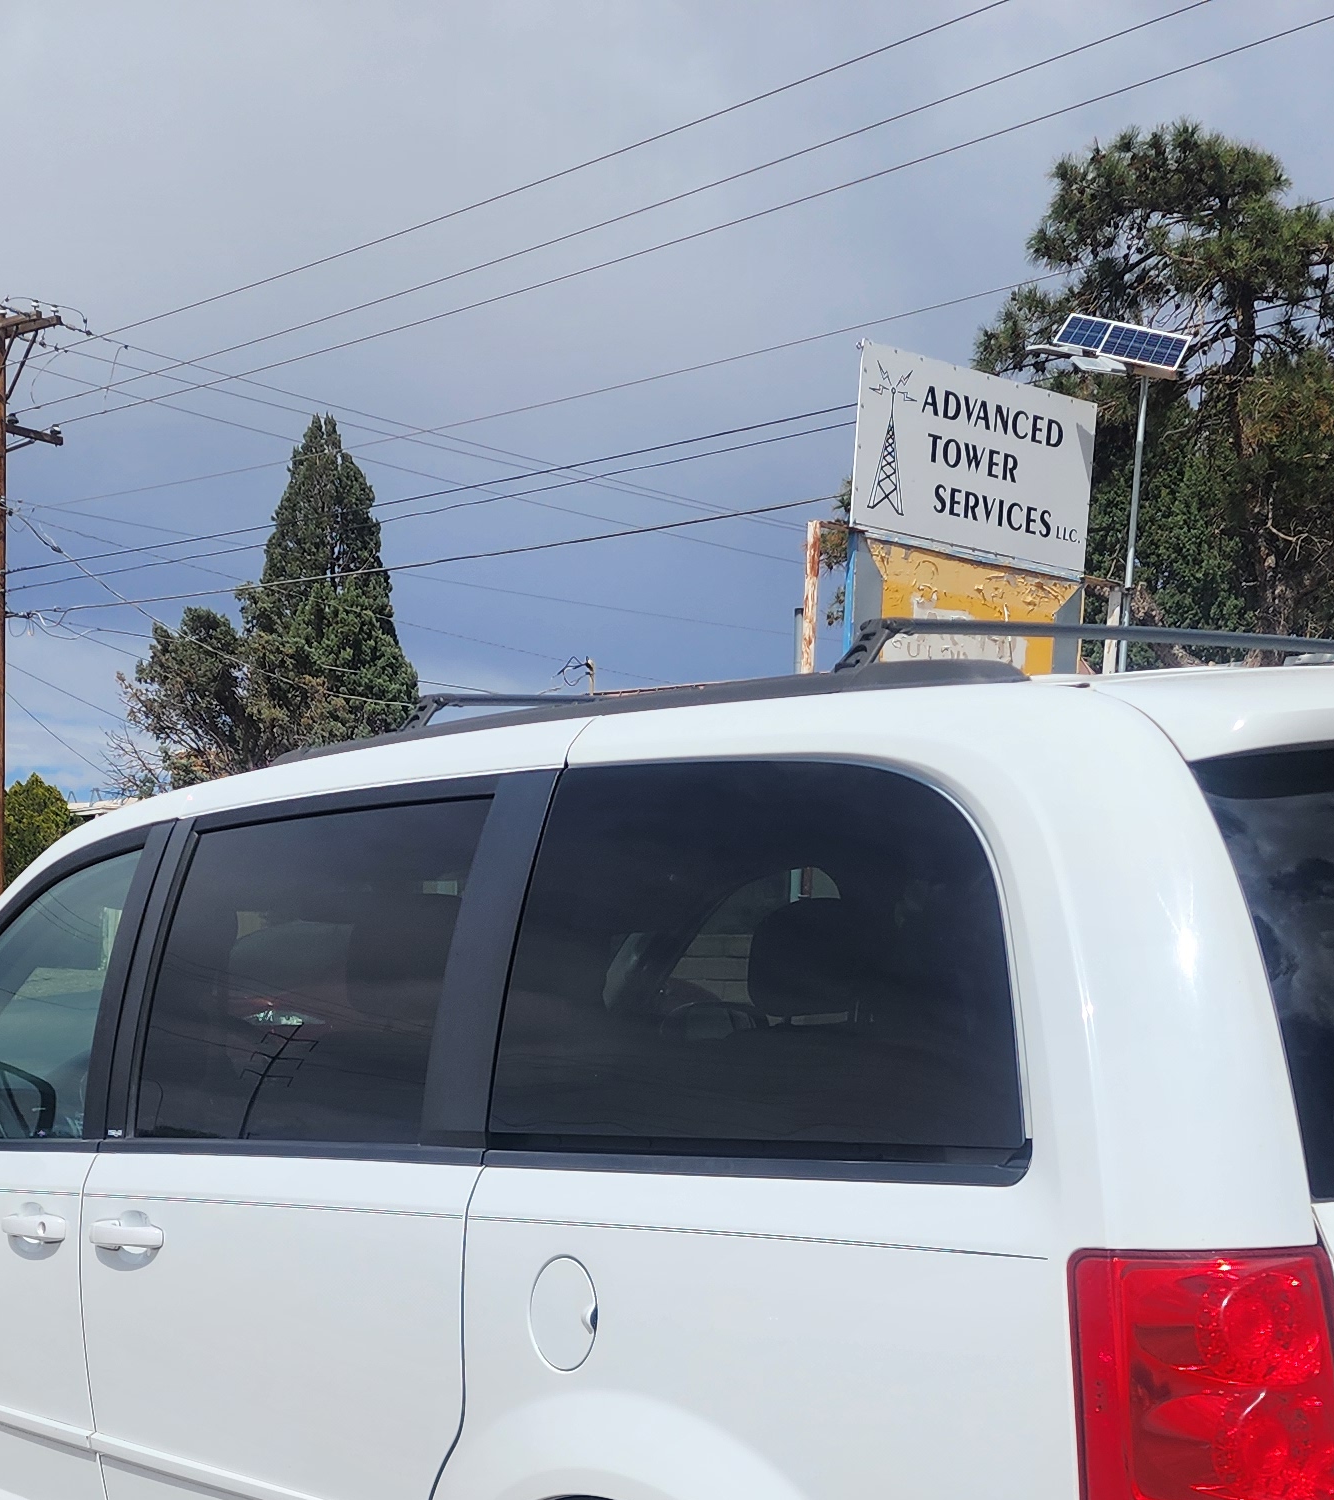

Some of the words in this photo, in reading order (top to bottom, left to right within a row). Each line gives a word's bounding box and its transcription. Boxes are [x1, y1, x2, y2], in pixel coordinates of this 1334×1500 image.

[921, 385, 1064, 448] ADVANCED
[927, 432, 1018, 484] TOWER
[933, 483, 1052, 538] SERVICES
[1055, 525, 1081, 544] LLC.
